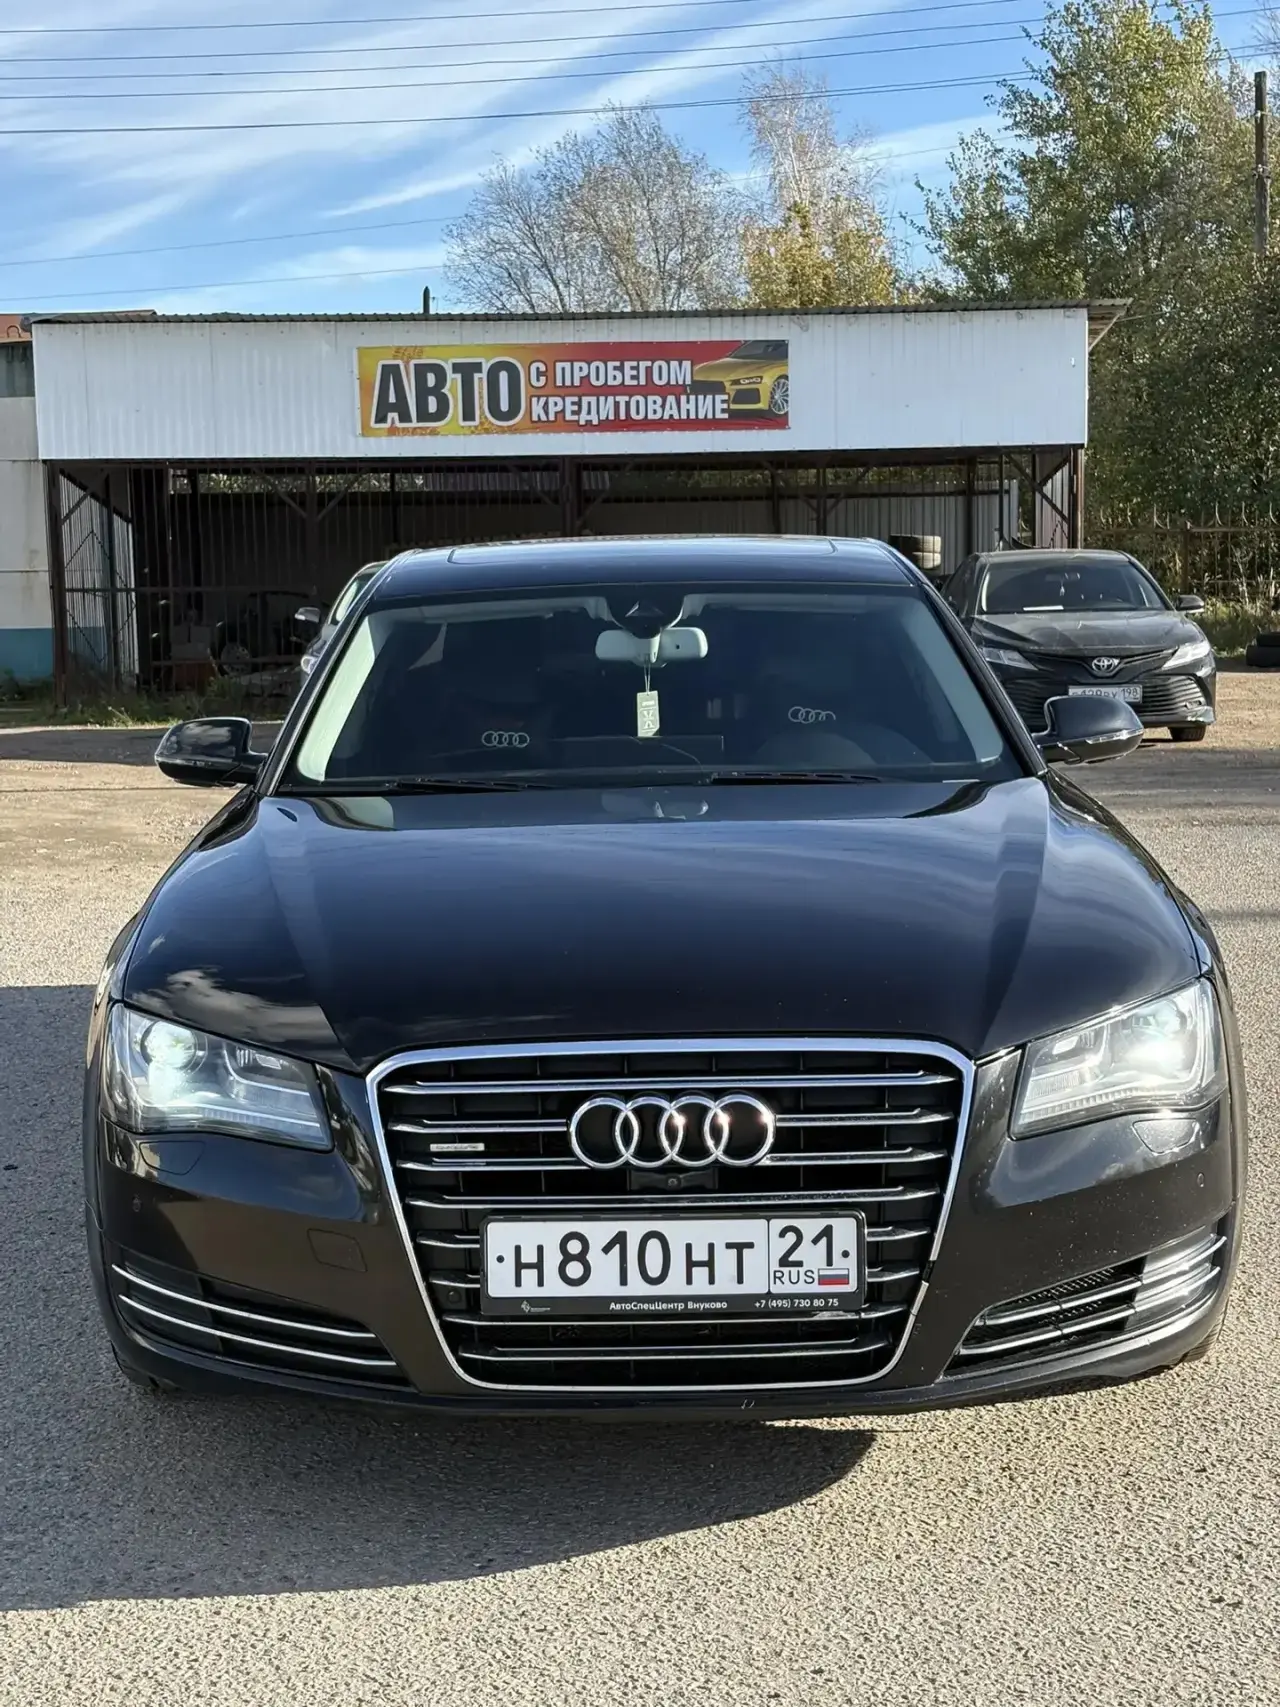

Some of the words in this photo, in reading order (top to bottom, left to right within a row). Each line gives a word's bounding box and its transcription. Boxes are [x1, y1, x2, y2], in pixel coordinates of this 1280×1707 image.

[529, 361, 548, 388] С
[554, 360, 693, 388] ПРОБЕГОМ
[372, 358, 524, 427] АВТО
[530, 394, 730, 426] КРЕДИТОВАНИЕ
[514, 1230, 755, 1288] Н810НТ
[778, 1224, 834, 1268] 21
[773, 1269, 816, 1285] RUS
[609, 1301, 685, 1312] АвтоСпецЦентр
[687, 1301, 728, 1311] Внуково
[754, 1300, 766, 1308] +7
[767, 1299, 791, 1309] (495)
[793, 1299, 811, 1308] 730
[812, 1298, 825, 1308] 80
[827, 1298, 840, 1307] 75
